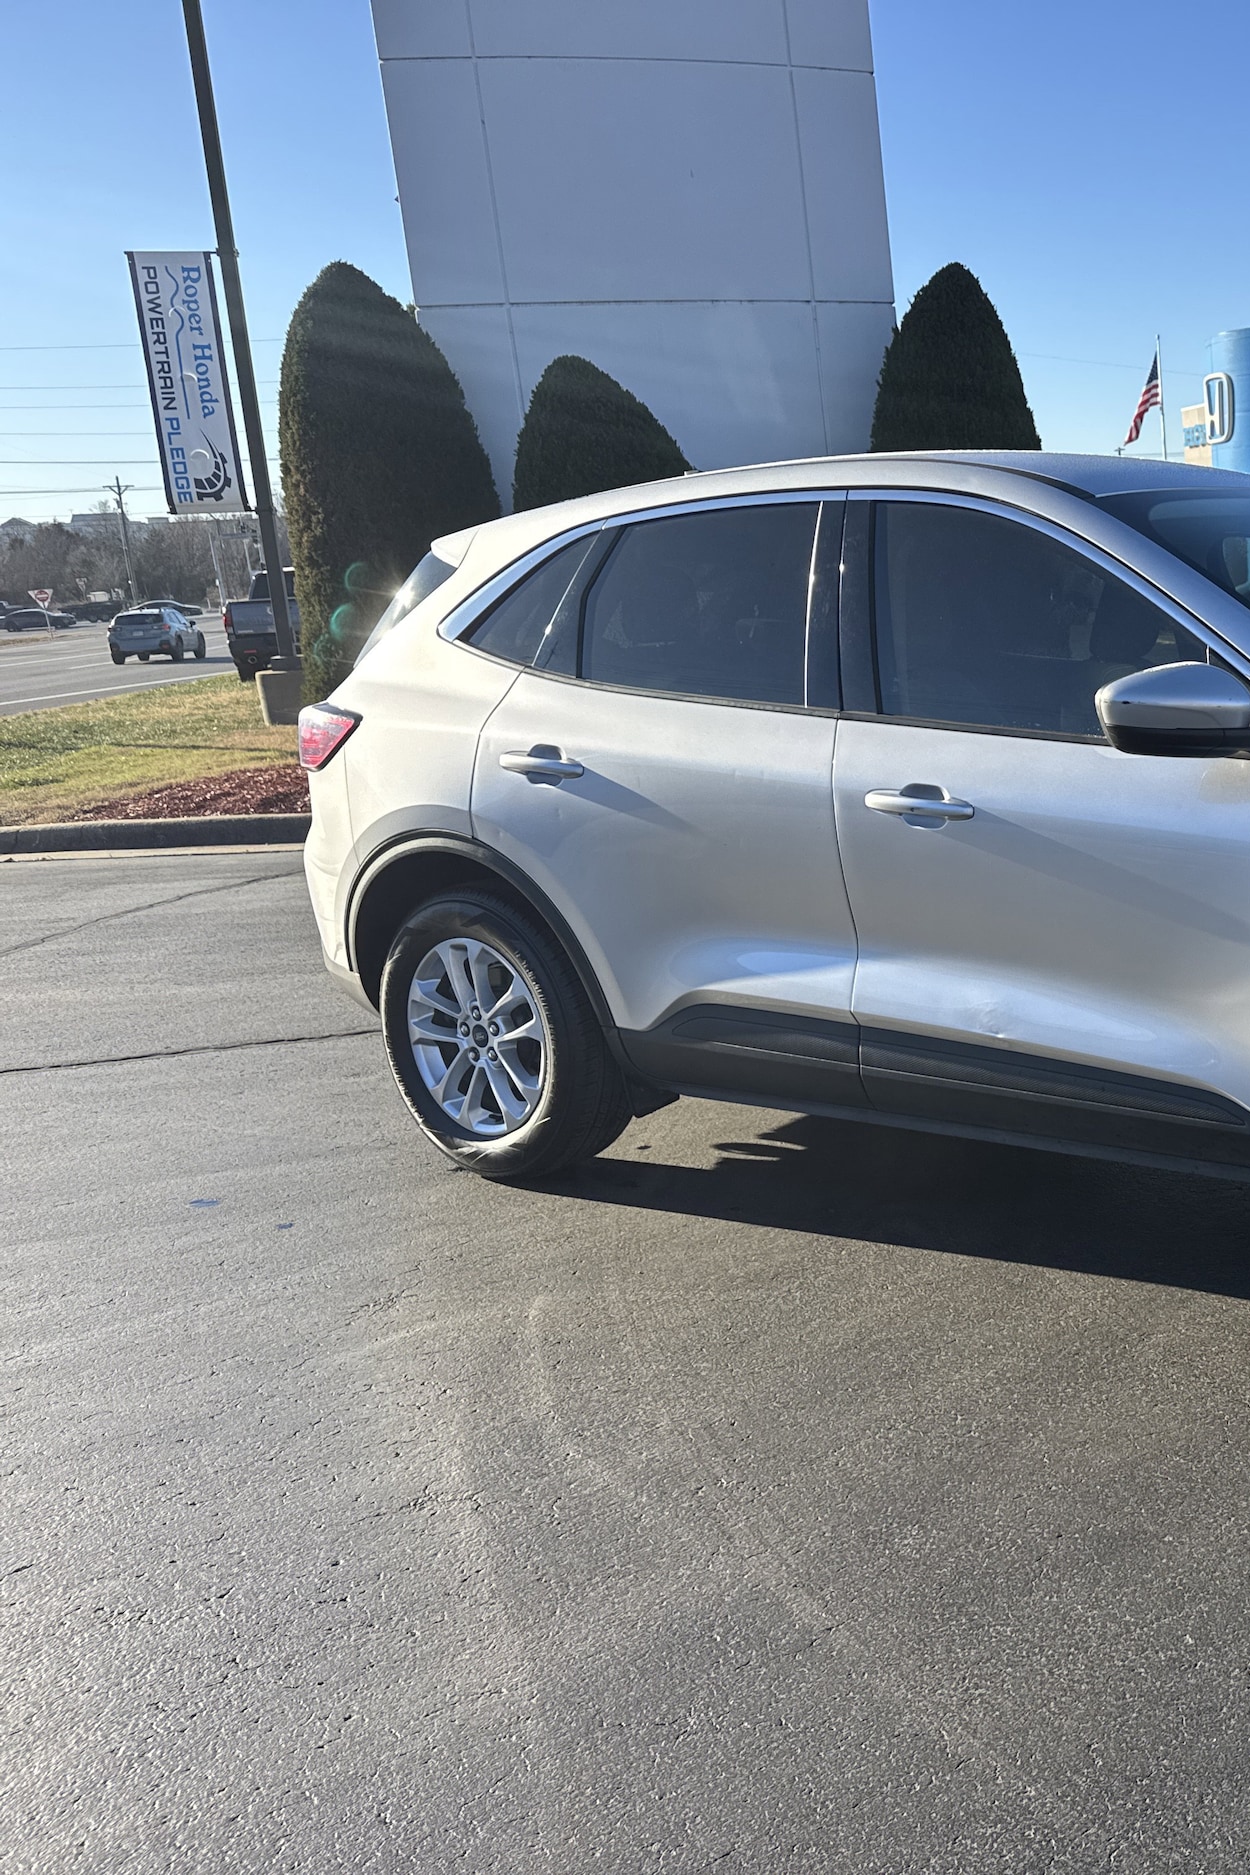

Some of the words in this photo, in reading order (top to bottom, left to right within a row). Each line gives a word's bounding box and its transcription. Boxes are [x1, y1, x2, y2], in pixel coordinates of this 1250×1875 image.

[141, 266, 177, 411] POWERTRAIN
[165, 417, 194, 504] PLEDGE
[181, 265, 203, 336] Roper
[192, 343, 219, 419] Honda
